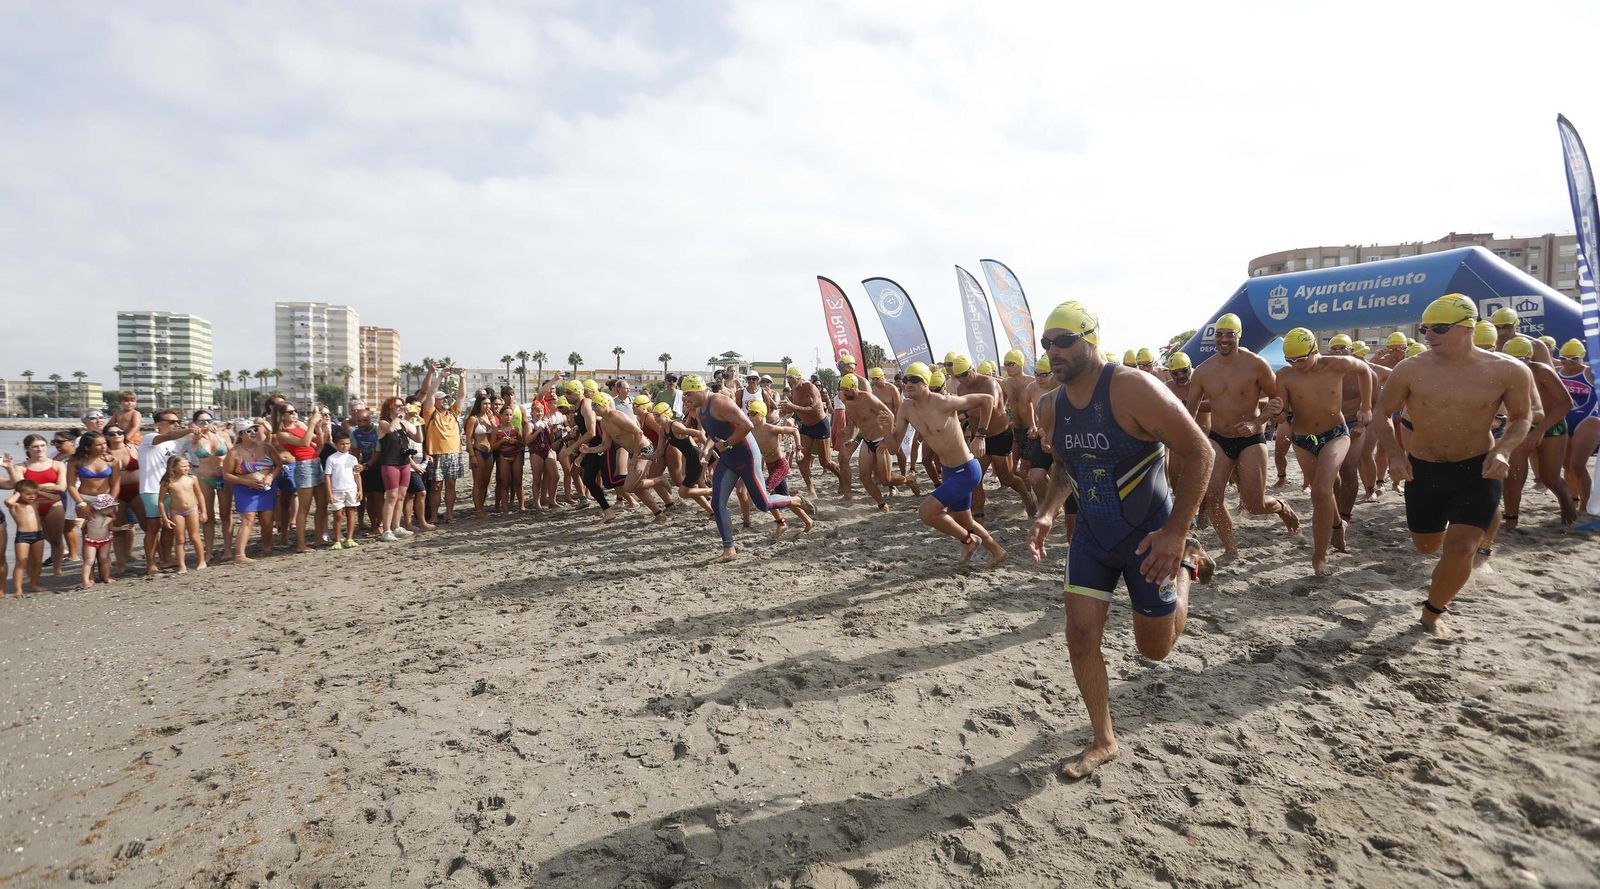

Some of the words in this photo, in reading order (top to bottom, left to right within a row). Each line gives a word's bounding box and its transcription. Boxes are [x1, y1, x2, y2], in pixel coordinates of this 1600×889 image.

[1294, 272, 1426, 299] Ayuntamiento
[1307, 300, 1328, 314] de
[1332, 298, 1353, 312] La
[1357, 293, 1411, 310] Línea
[1515, 323, 1545, 333] RTES
[1065, 433, 1110, 450] BALDO
